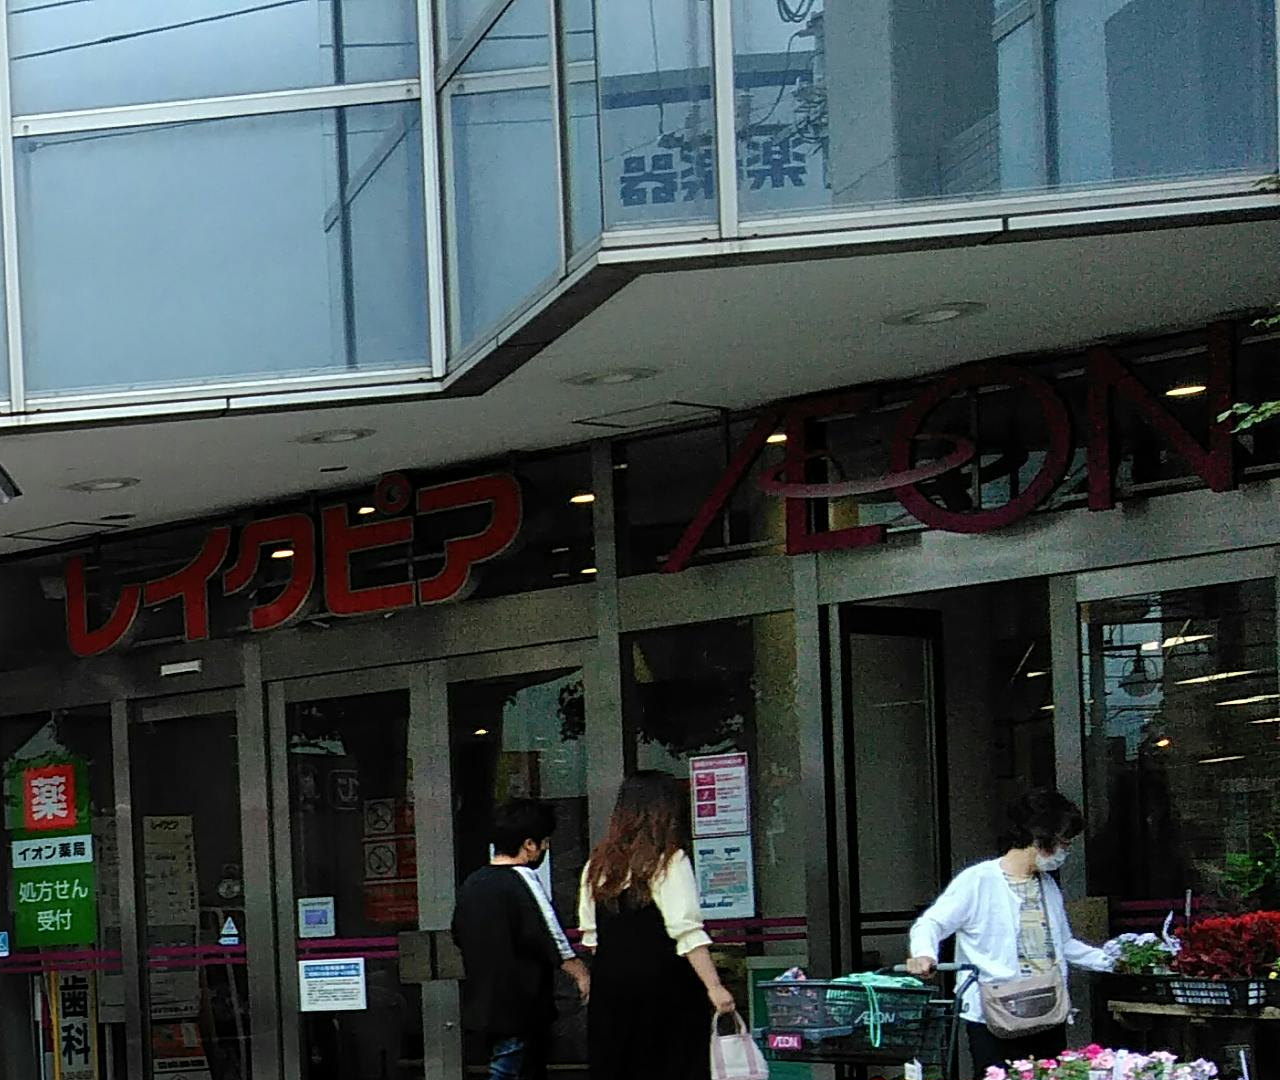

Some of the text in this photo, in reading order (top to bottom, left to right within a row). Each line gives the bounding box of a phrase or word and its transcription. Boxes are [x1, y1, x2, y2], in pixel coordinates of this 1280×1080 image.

[64, 472, 524, 657] レイクピア
[30, 776, 69, 821] 薬
[18, 841, 87, 862] イオン薬局
[18, 878, 89, 904] 処方せん
[36, 909, 73, 932] 受付
[58, 974, 91, 1066] 歯科
